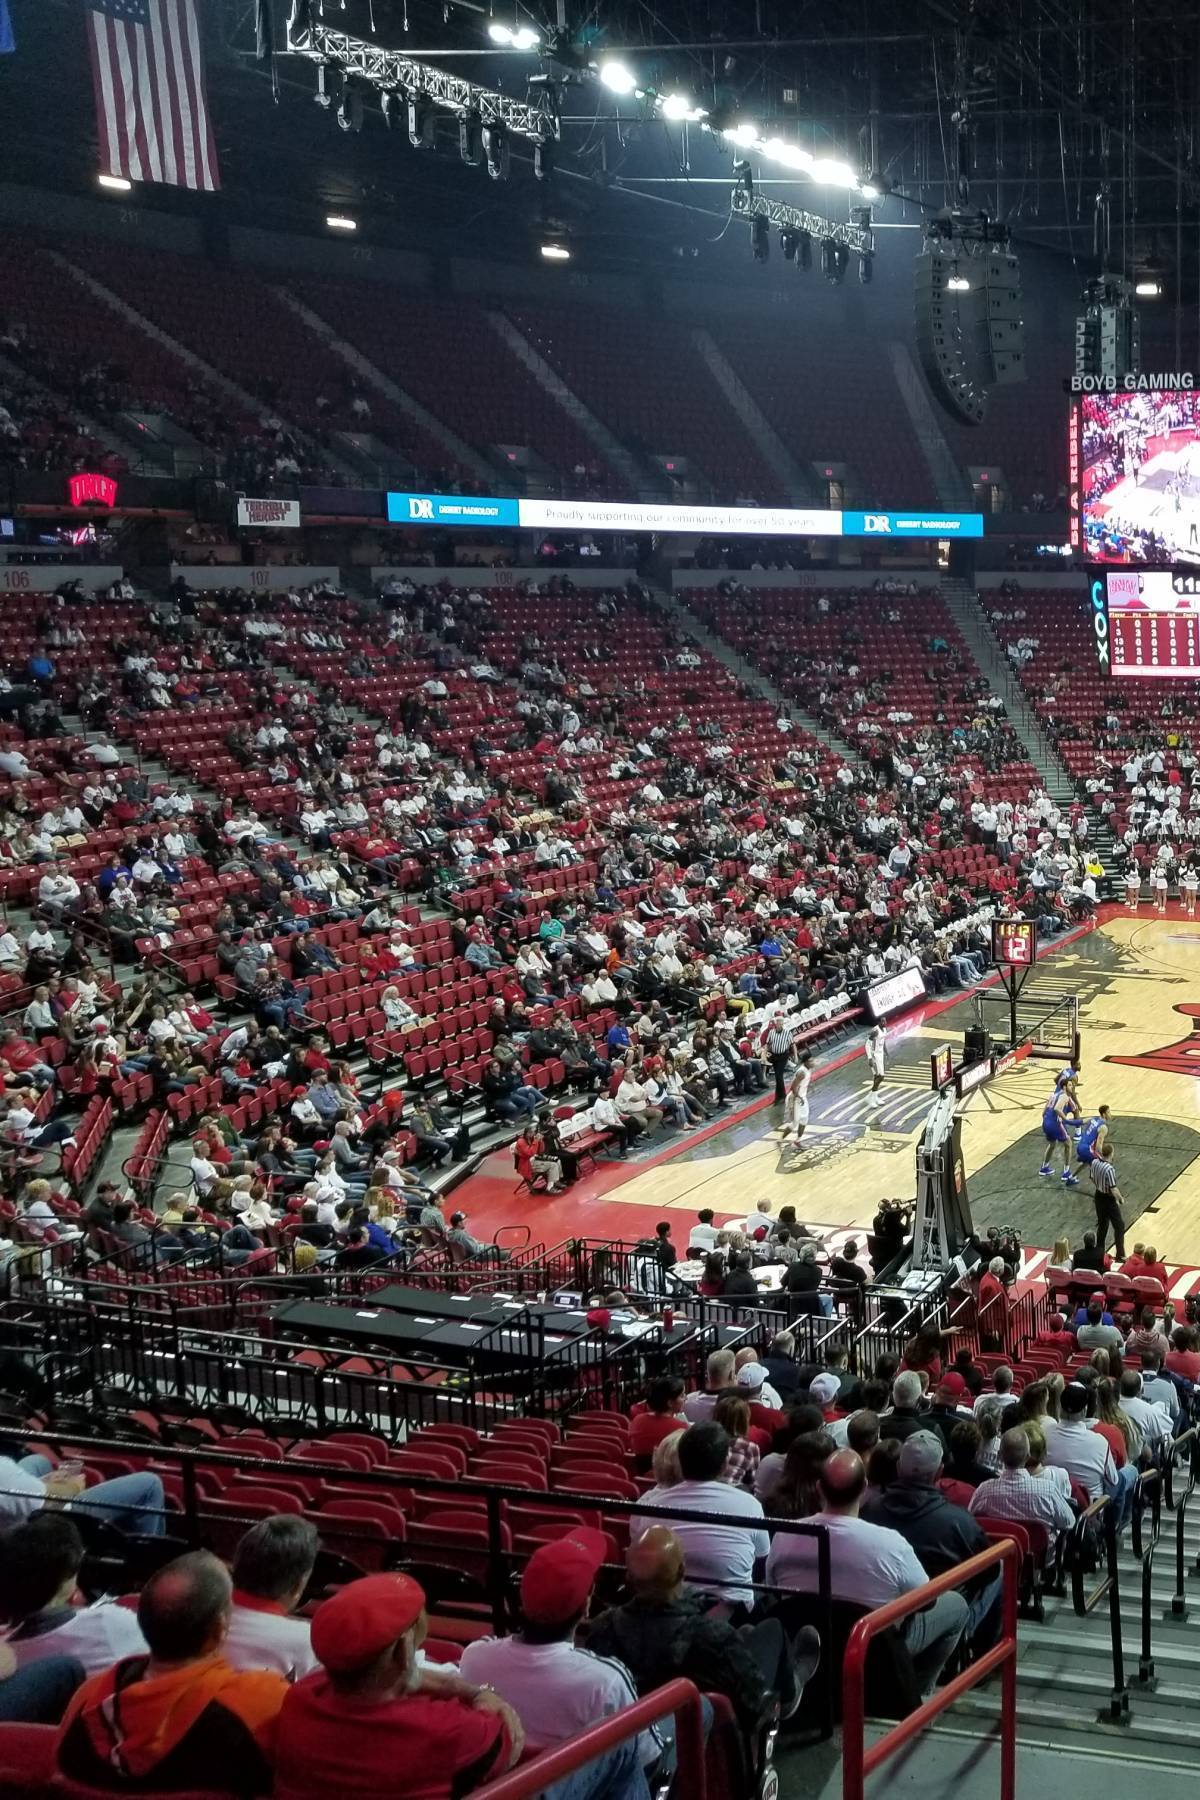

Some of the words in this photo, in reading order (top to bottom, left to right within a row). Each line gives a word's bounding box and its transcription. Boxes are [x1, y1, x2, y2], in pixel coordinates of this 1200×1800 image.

[1071, 375, 1117, 391] BOYD
[1124, 372, 1194, 390] GAMING
[408, 498, 435, 519] DR
[546, 508, 584, 521] Proudly
[588, 511, 643, 523] supporting
[646, 514, 663, 522] our
[667, 514, 724, 526] community
[864, 515, 892, 533] DR
[3, 571, 29, 588] 106
[251, 571, 270, 586] 107
[1092, 581, 1109, 664] COX
[1115, 619, 1120, 627] 1
[1115, 656, 1125, 664] 34
[1008, 937, 1026, 960] 12
